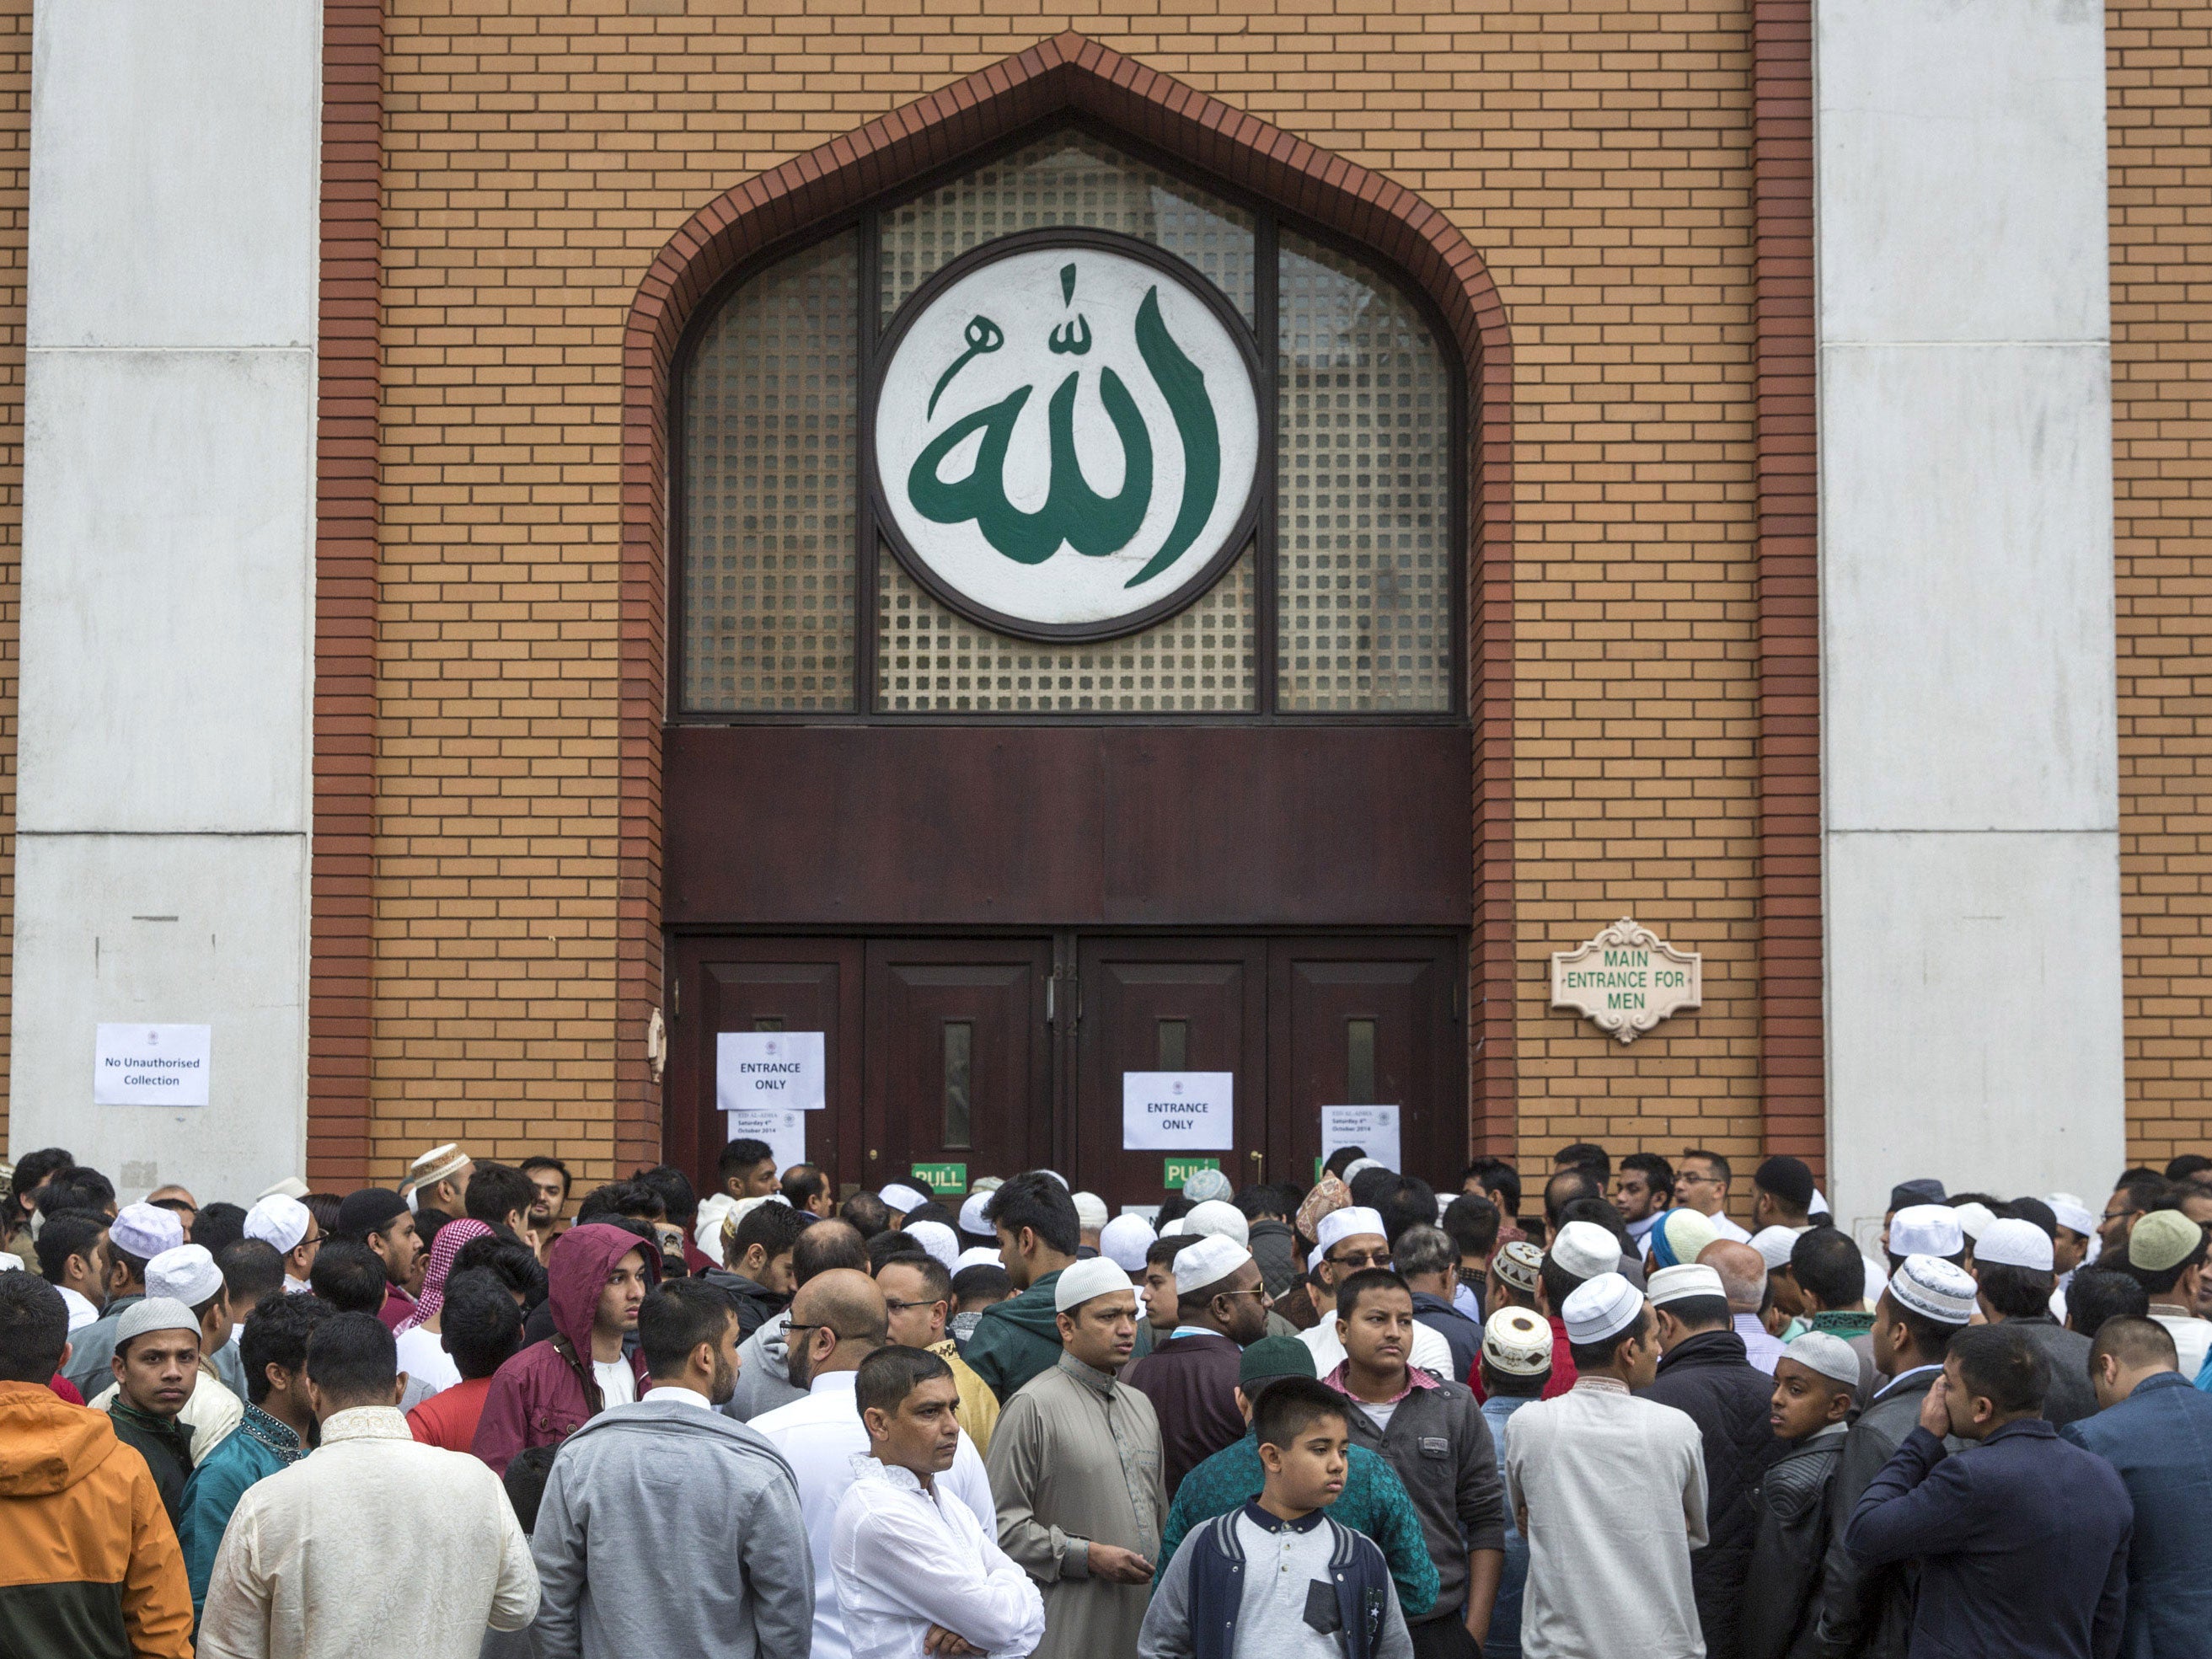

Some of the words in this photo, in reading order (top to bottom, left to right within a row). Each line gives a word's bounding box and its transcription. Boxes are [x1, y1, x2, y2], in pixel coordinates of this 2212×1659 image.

[1604, 950, 1649, 967] MAIN
[1567, 971, 1647, 988] ENTRANCE
[1655, 971, 1684, 987] FOR
[1608, 993, 1646, 1009] MEN
[104, 1057, 121, 1068] No
[124, 1057, 201, 1068] Unauthorised
[740, 1062, 801, 1073] ENTRANCE
[124, 1075, 180, 1086] Collection
[755, 1079, 786, 1090] ONLY
[1147, 1102, 1209, 1114] ENTRANCE
[1162, 1119, 1194, 1130] ONLY
